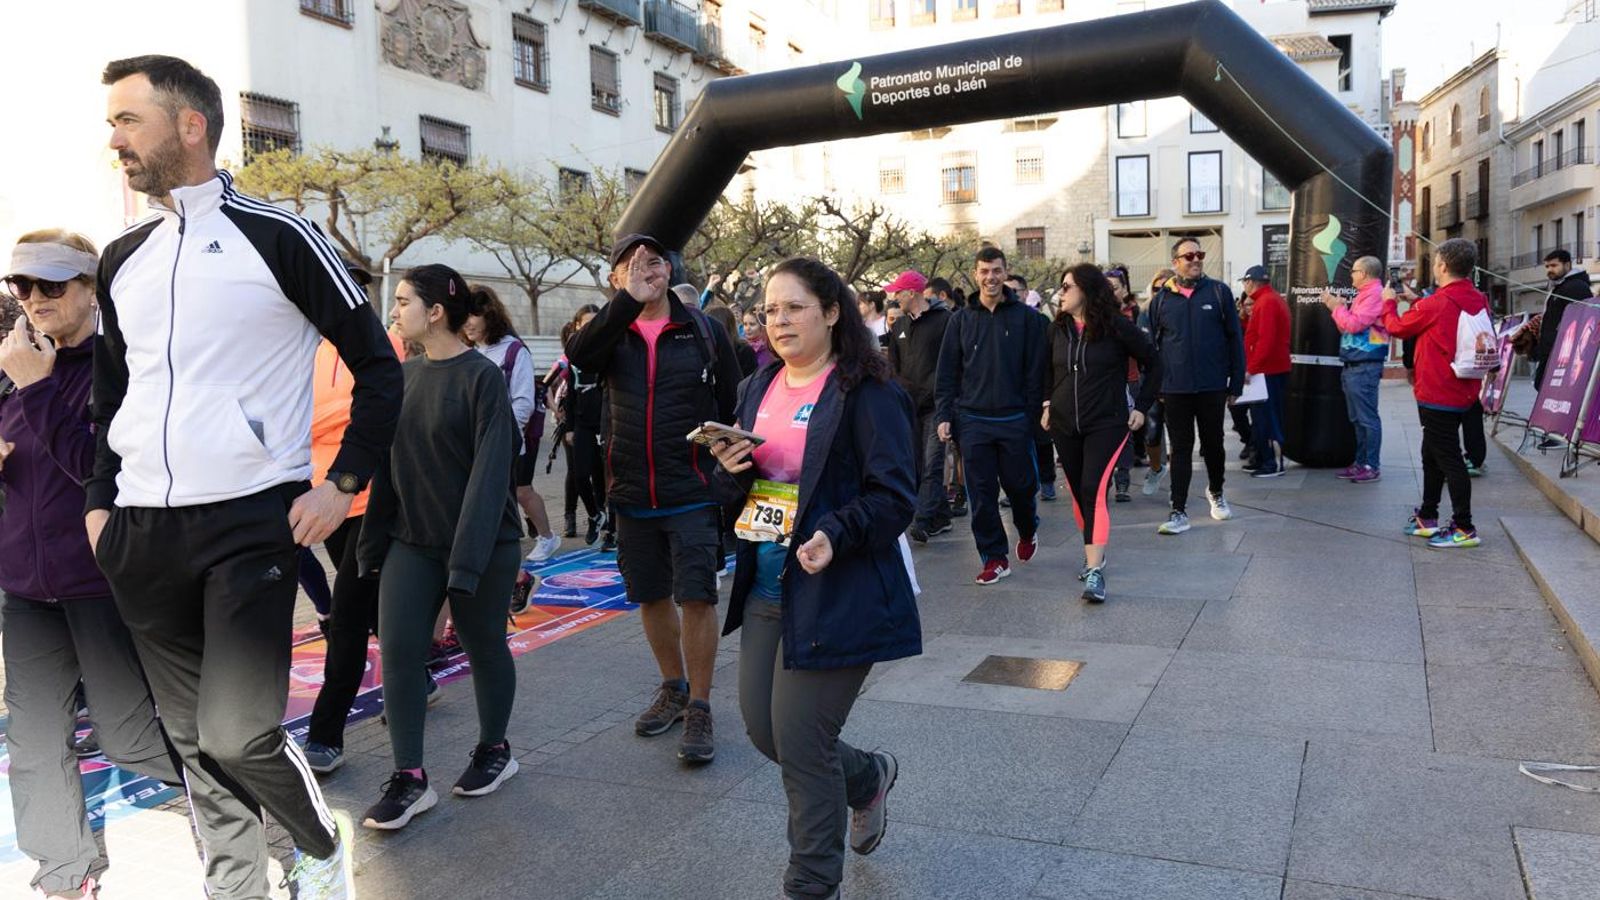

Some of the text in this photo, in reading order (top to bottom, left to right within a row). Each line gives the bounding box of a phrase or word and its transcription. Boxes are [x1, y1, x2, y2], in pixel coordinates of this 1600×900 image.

[870, 55, 1023, 89] Patronato Municipal de
[871, 77, 987, 105] Deportes de Jaén
[1296, 295, 1322, 305] Deport
[1325, 286, 1360, 296] Municip
[754, 504, 784, 526] 739
